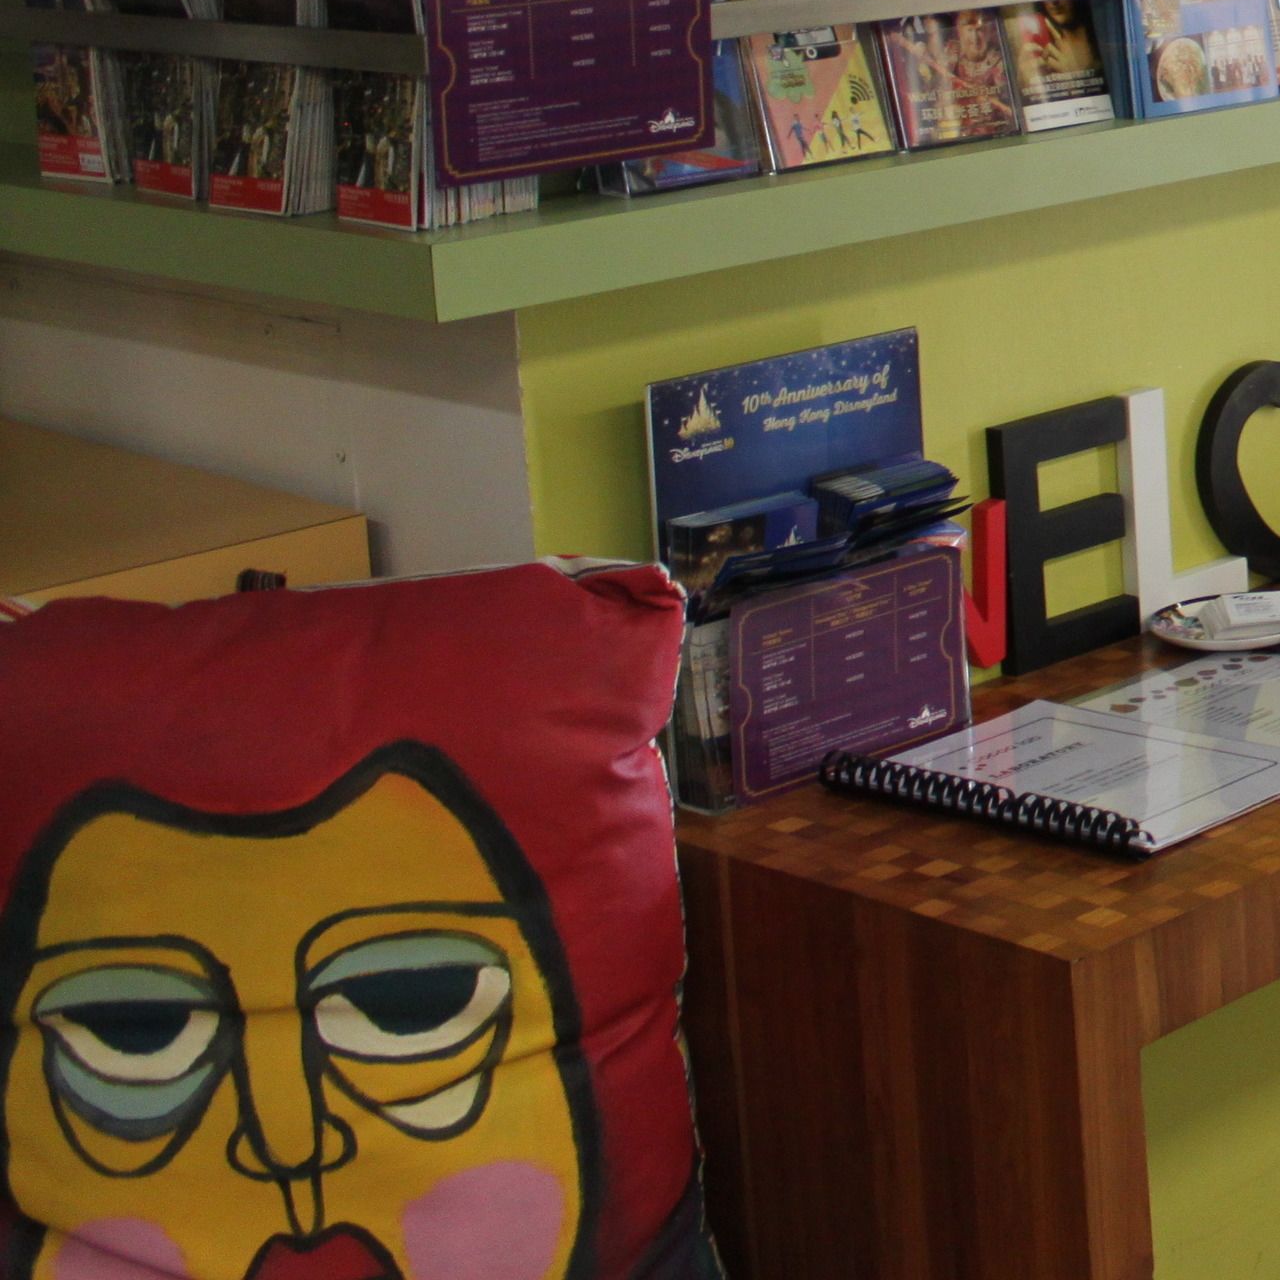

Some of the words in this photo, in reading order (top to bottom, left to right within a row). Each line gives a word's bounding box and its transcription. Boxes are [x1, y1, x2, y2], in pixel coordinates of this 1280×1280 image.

[742, 391, 771, 415] 10th
[772, 373, 869, 408] Anniversary
[872, 364, 891, 389] of
[763, 414, 796, 433] Hong
[799, 407, 831, 424] Kong
[832, 387, 898, 416] Disneyland
